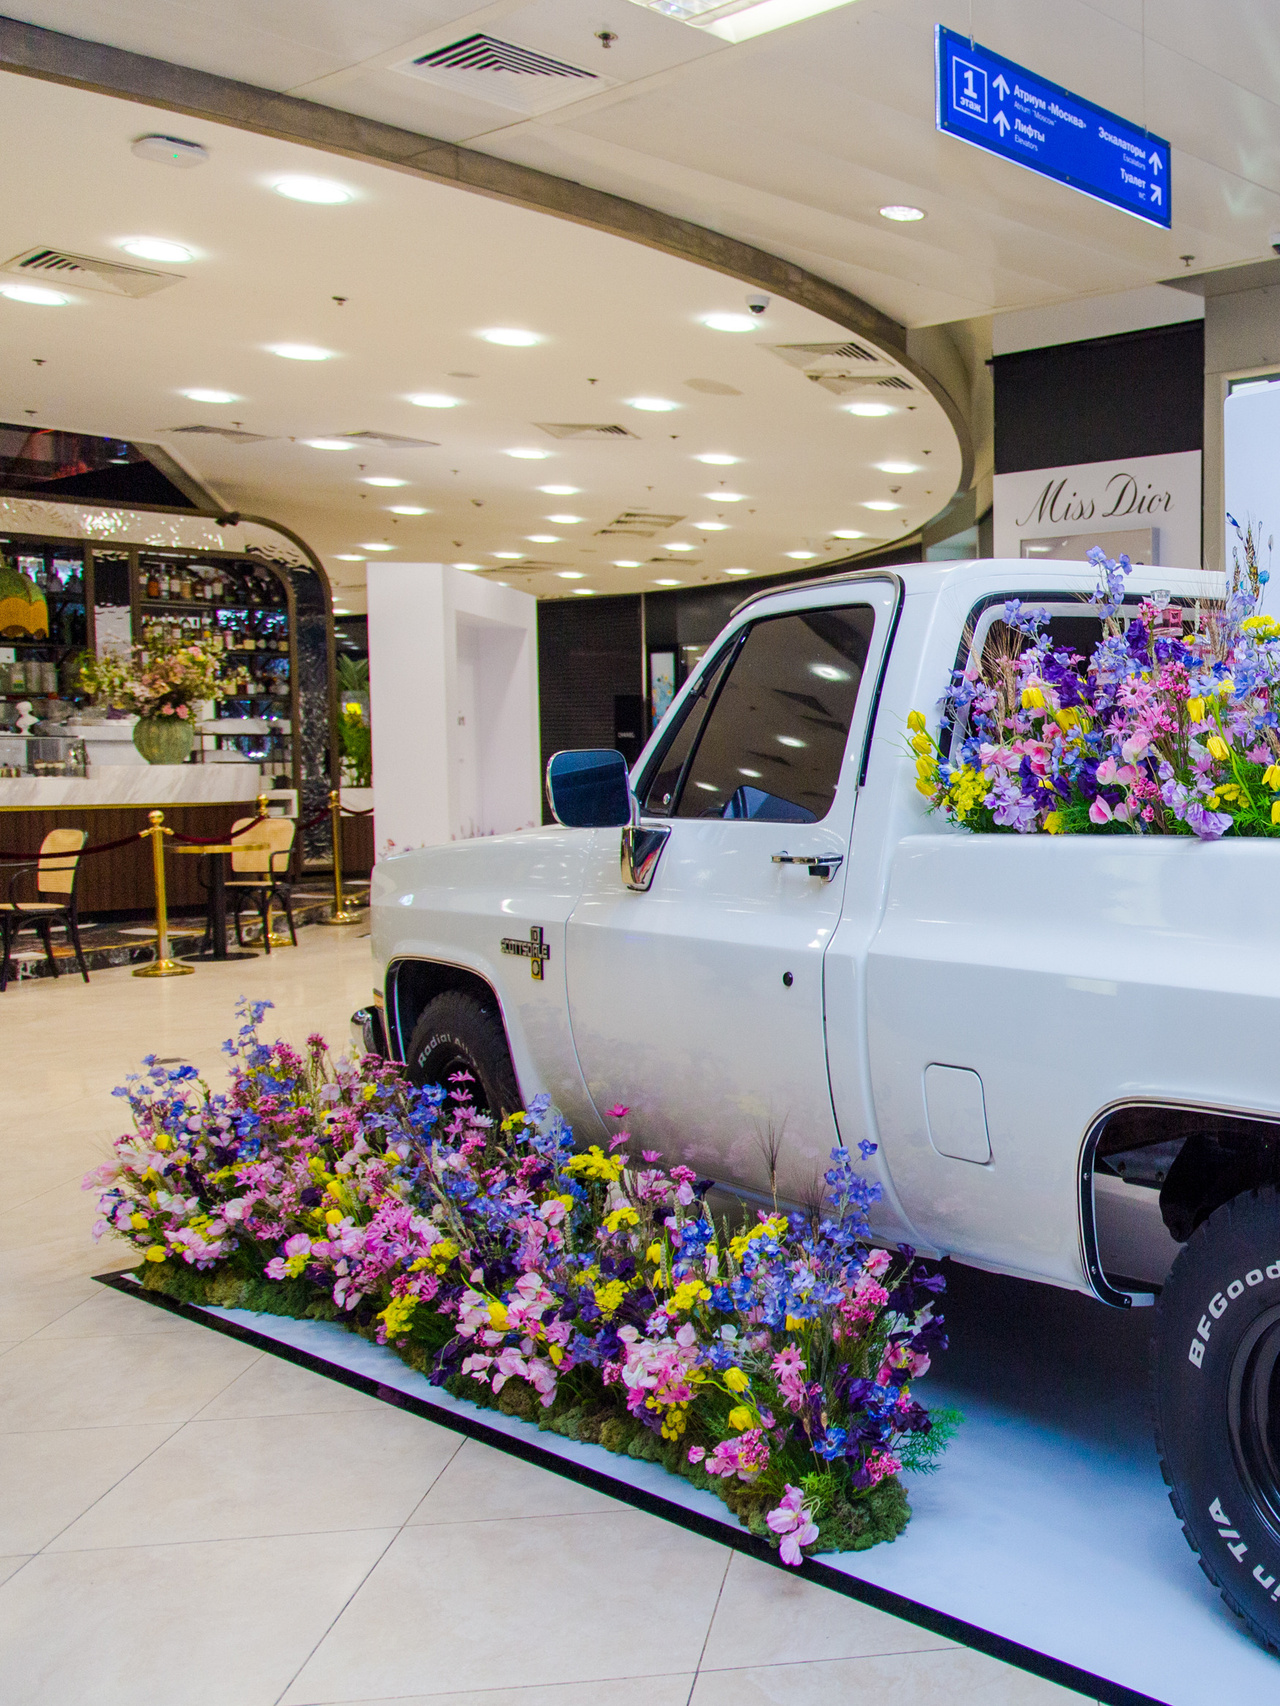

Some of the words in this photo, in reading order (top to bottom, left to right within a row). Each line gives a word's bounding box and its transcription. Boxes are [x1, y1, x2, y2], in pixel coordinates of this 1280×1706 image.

[963, 70, 978, 99] 1
[1013, 84, 1046, 110] Атриум
[960, 96, 982, 113] этаж
[1013, 118, 1045, 142] Лифты
[1098, 126, 1146, 159] Эскалаторы
[1120, 167, 1147, 189] Туалет
[1015, 478, 1096, 527] Miss
[1102, 472, 1176, 518] Dior
[417, 1033, 452, 1068] Radial
[1208, 1496, 1249, 1564] T/A
